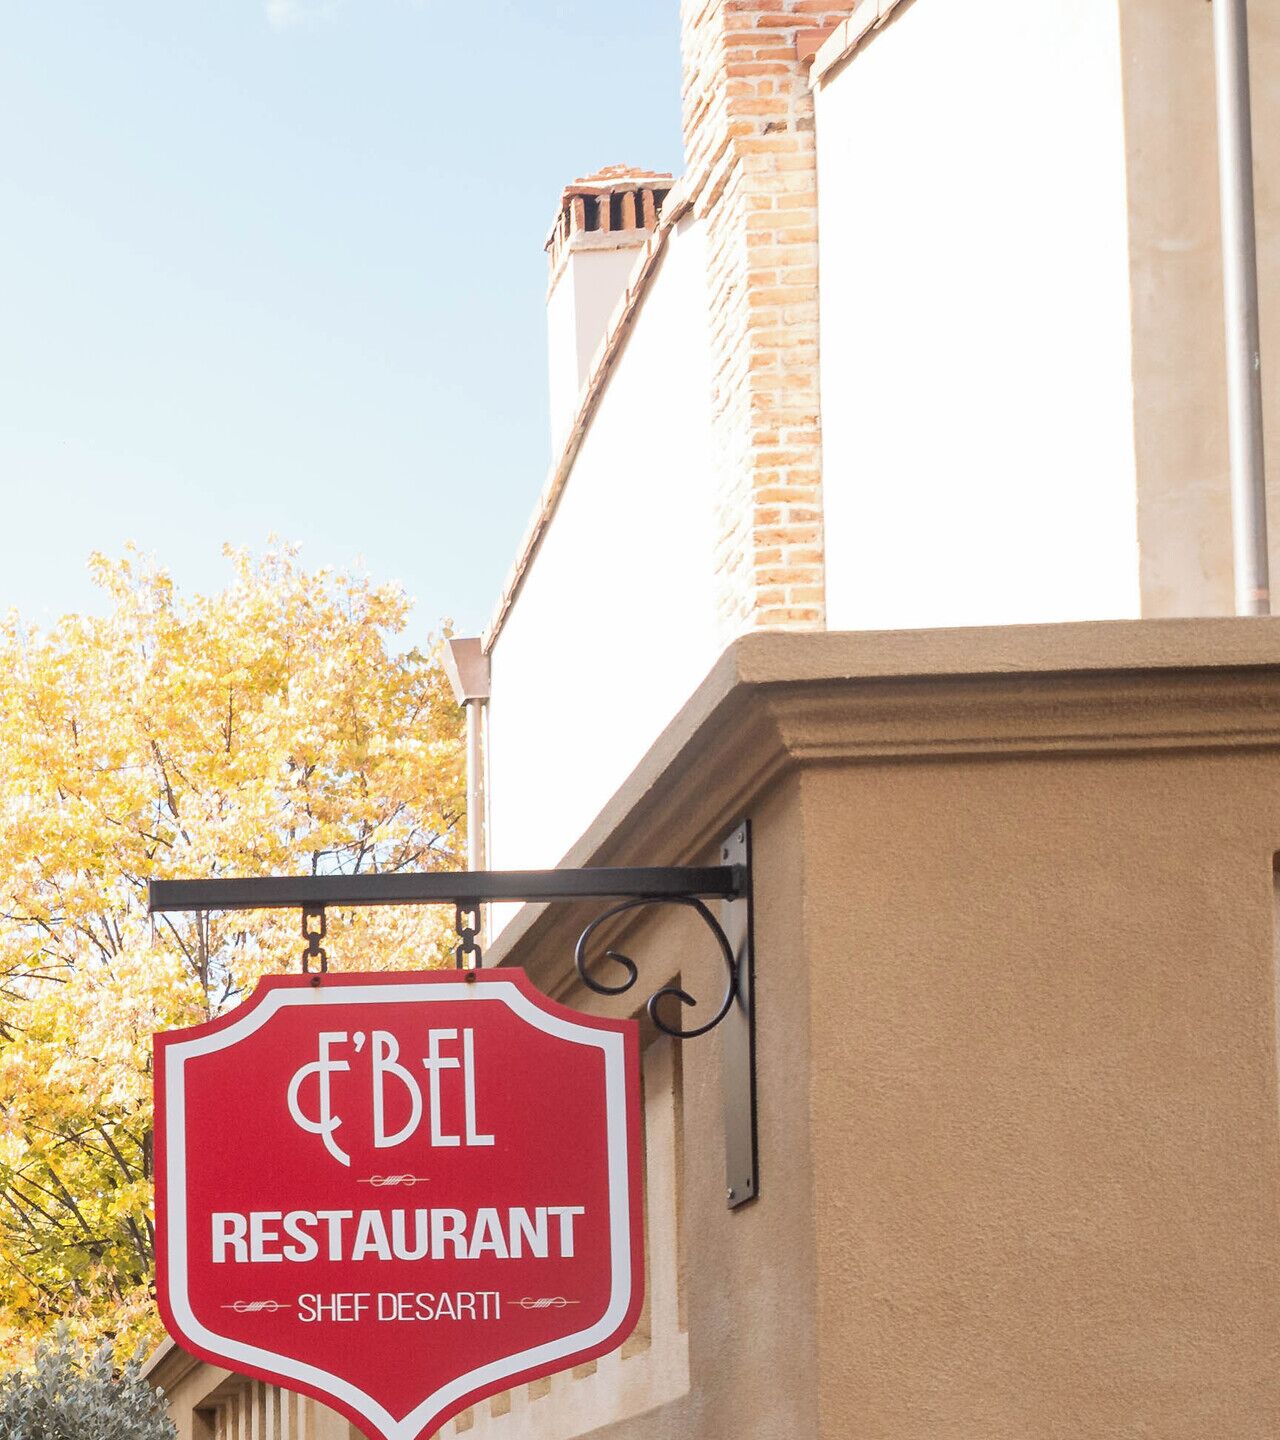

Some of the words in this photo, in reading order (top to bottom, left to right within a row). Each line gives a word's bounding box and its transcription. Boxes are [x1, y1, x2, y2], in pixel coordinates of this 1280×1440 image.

[211, 1205, 585, 1264] RESTAURANT
[297, 1292, 371, 1322] SHEF
[377, 1291, 501, 1322] DESARTI
